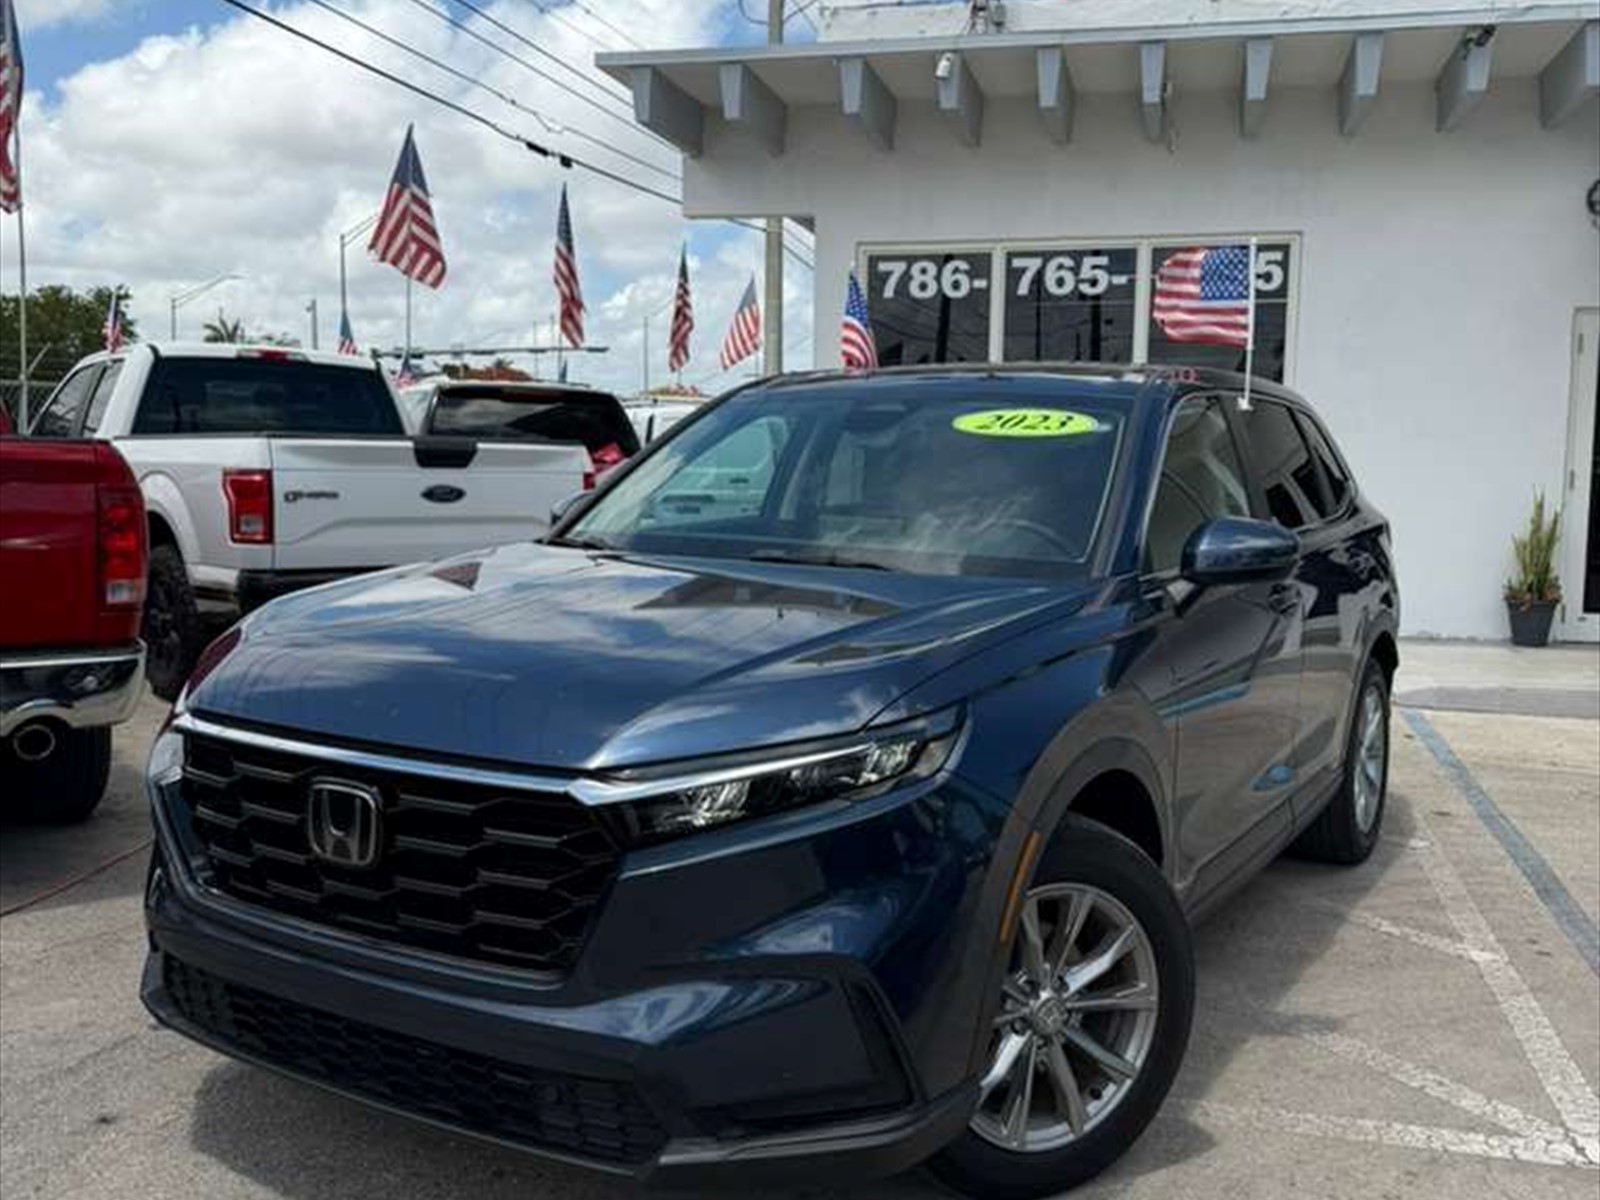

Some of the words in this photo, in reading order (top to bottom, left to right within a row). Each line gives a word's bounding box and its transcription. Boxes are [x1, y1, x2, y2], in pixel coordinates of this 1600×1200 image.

[877, 260, 988, 299] 786-
[1011, 256, 1129, 296] 765-
[974, 414, 1075, 431] 2023
